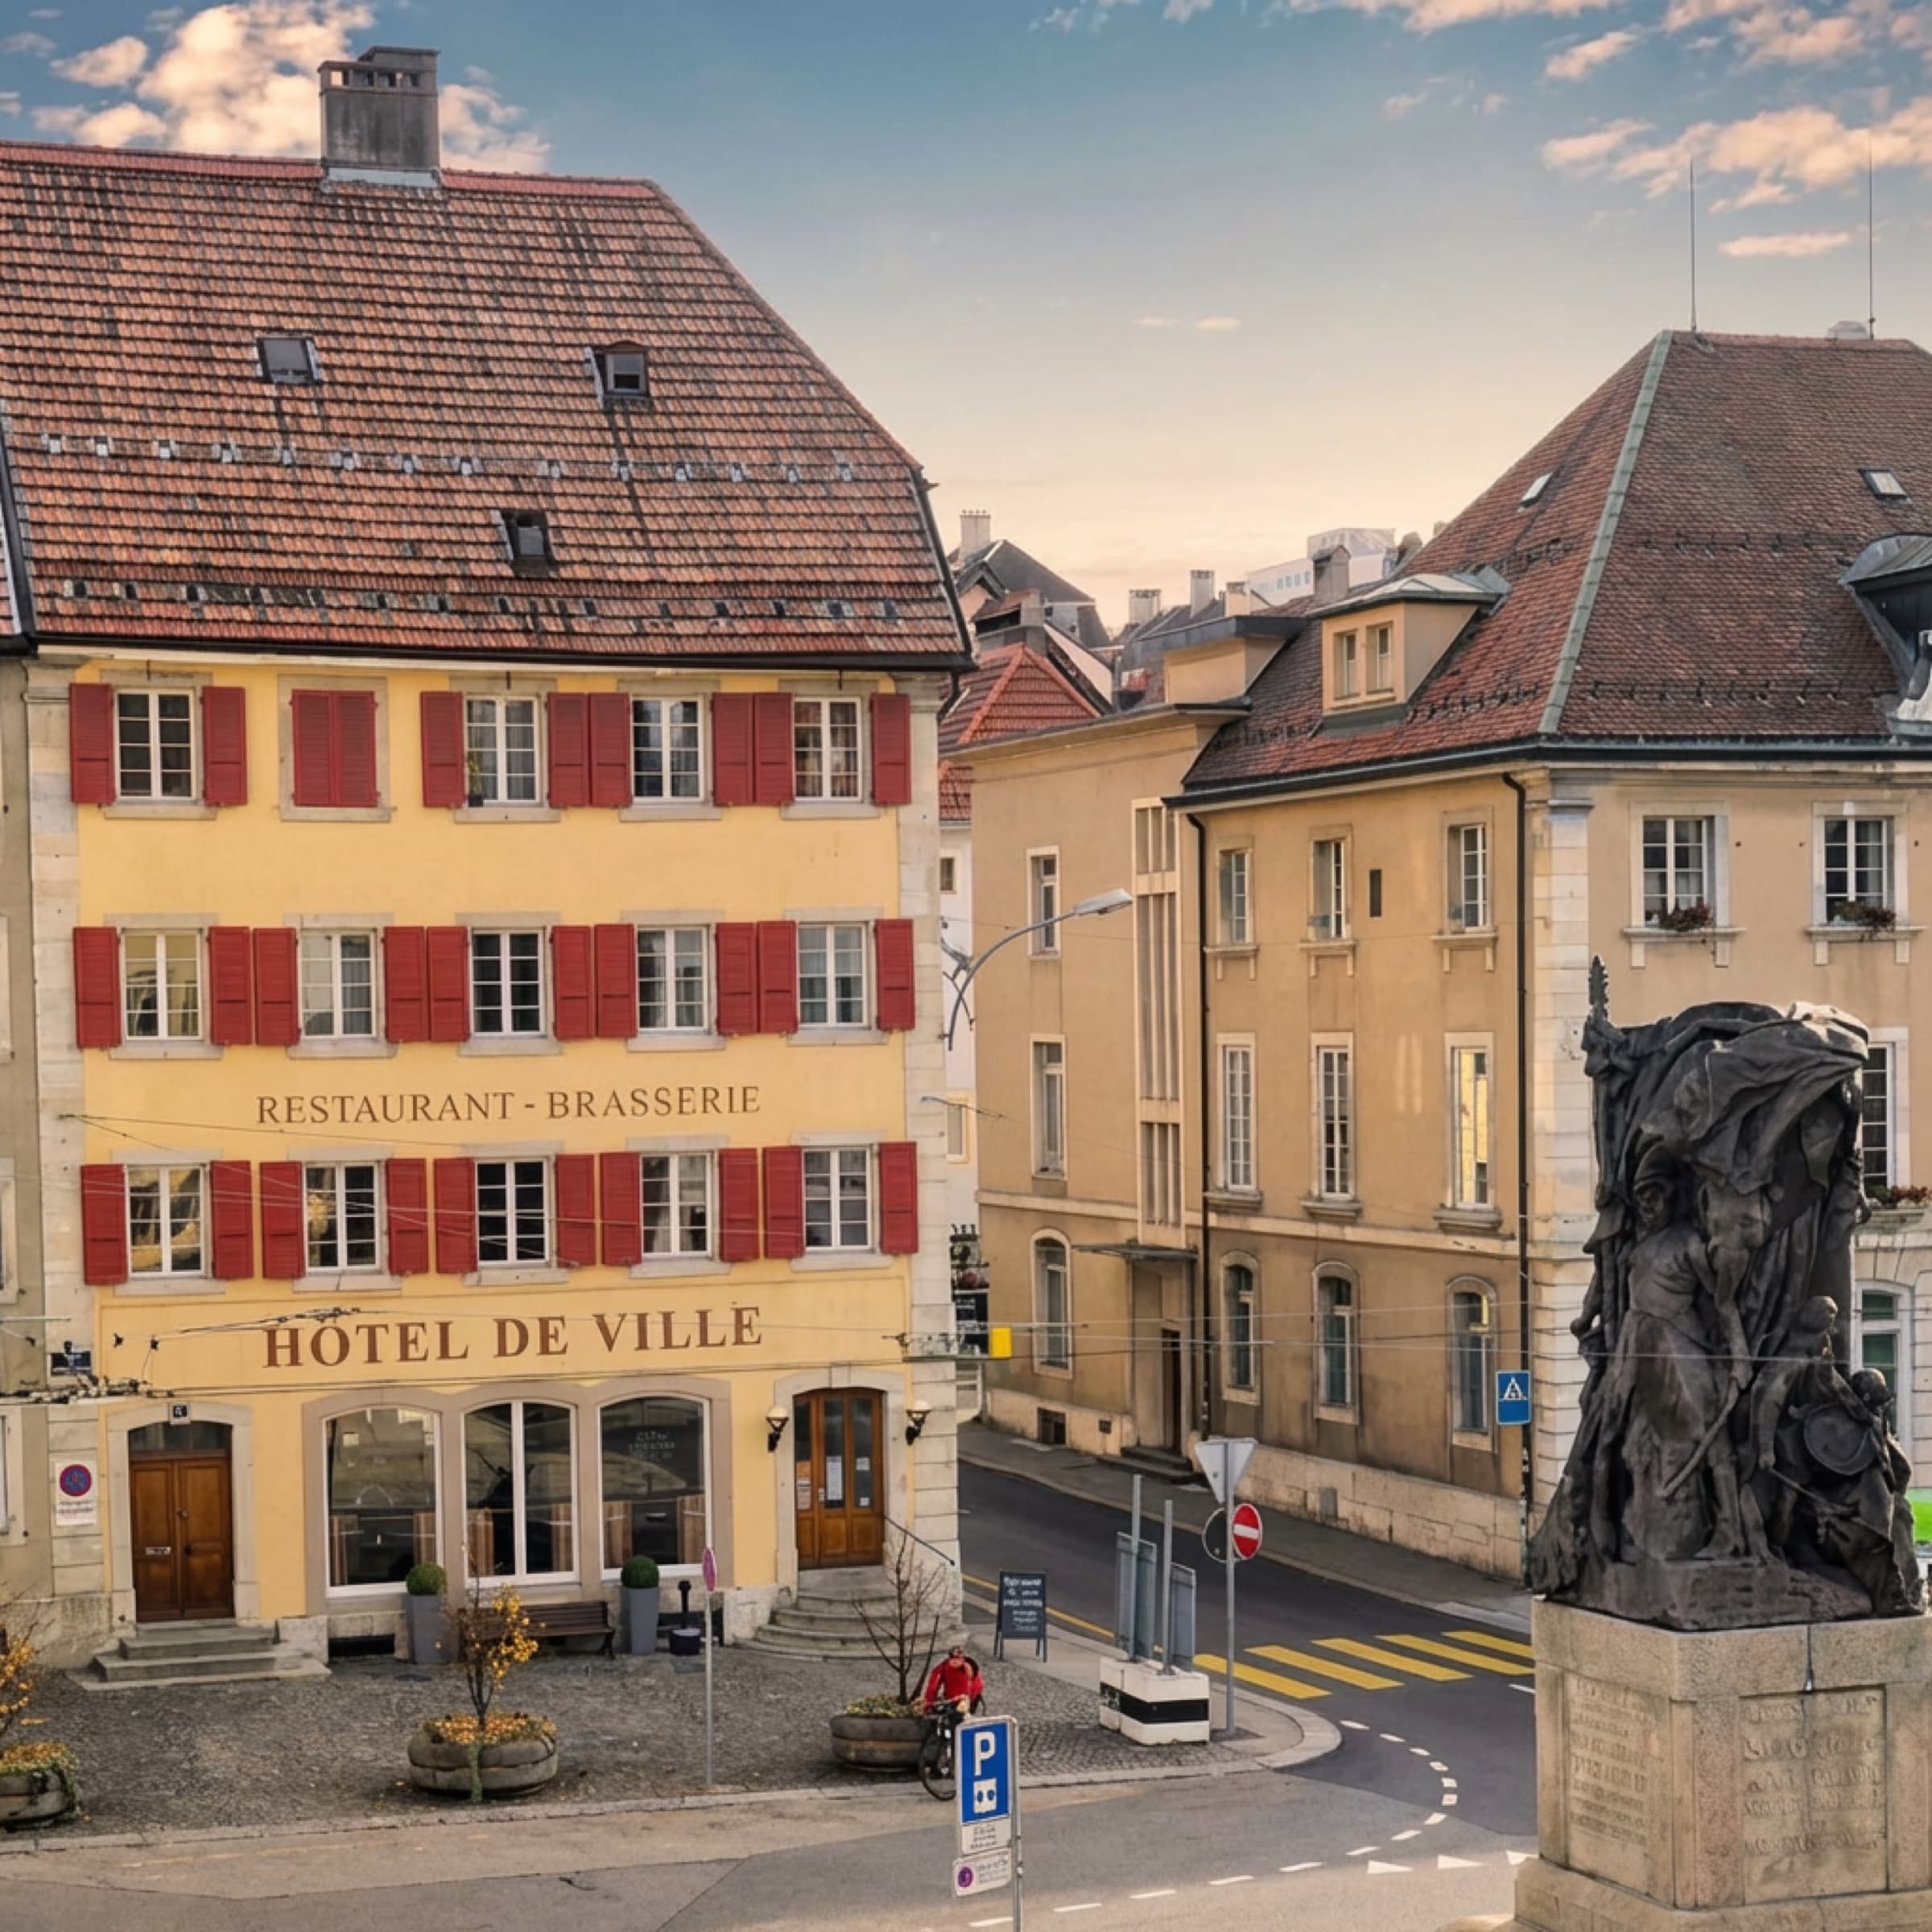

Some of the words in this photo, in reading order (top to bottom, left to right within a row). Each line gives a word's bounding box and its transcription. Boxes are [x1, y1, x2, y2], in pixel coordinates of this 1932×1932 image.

[257, 1092, 515, 1124] RESTAURANT
[547, 1086, 761, 1119] BRASSERIE
[493, 1315, 569, 1358] DE
[592, 1306, 762, 1353] VILLE
[974, 1731, 996, 1776] P
